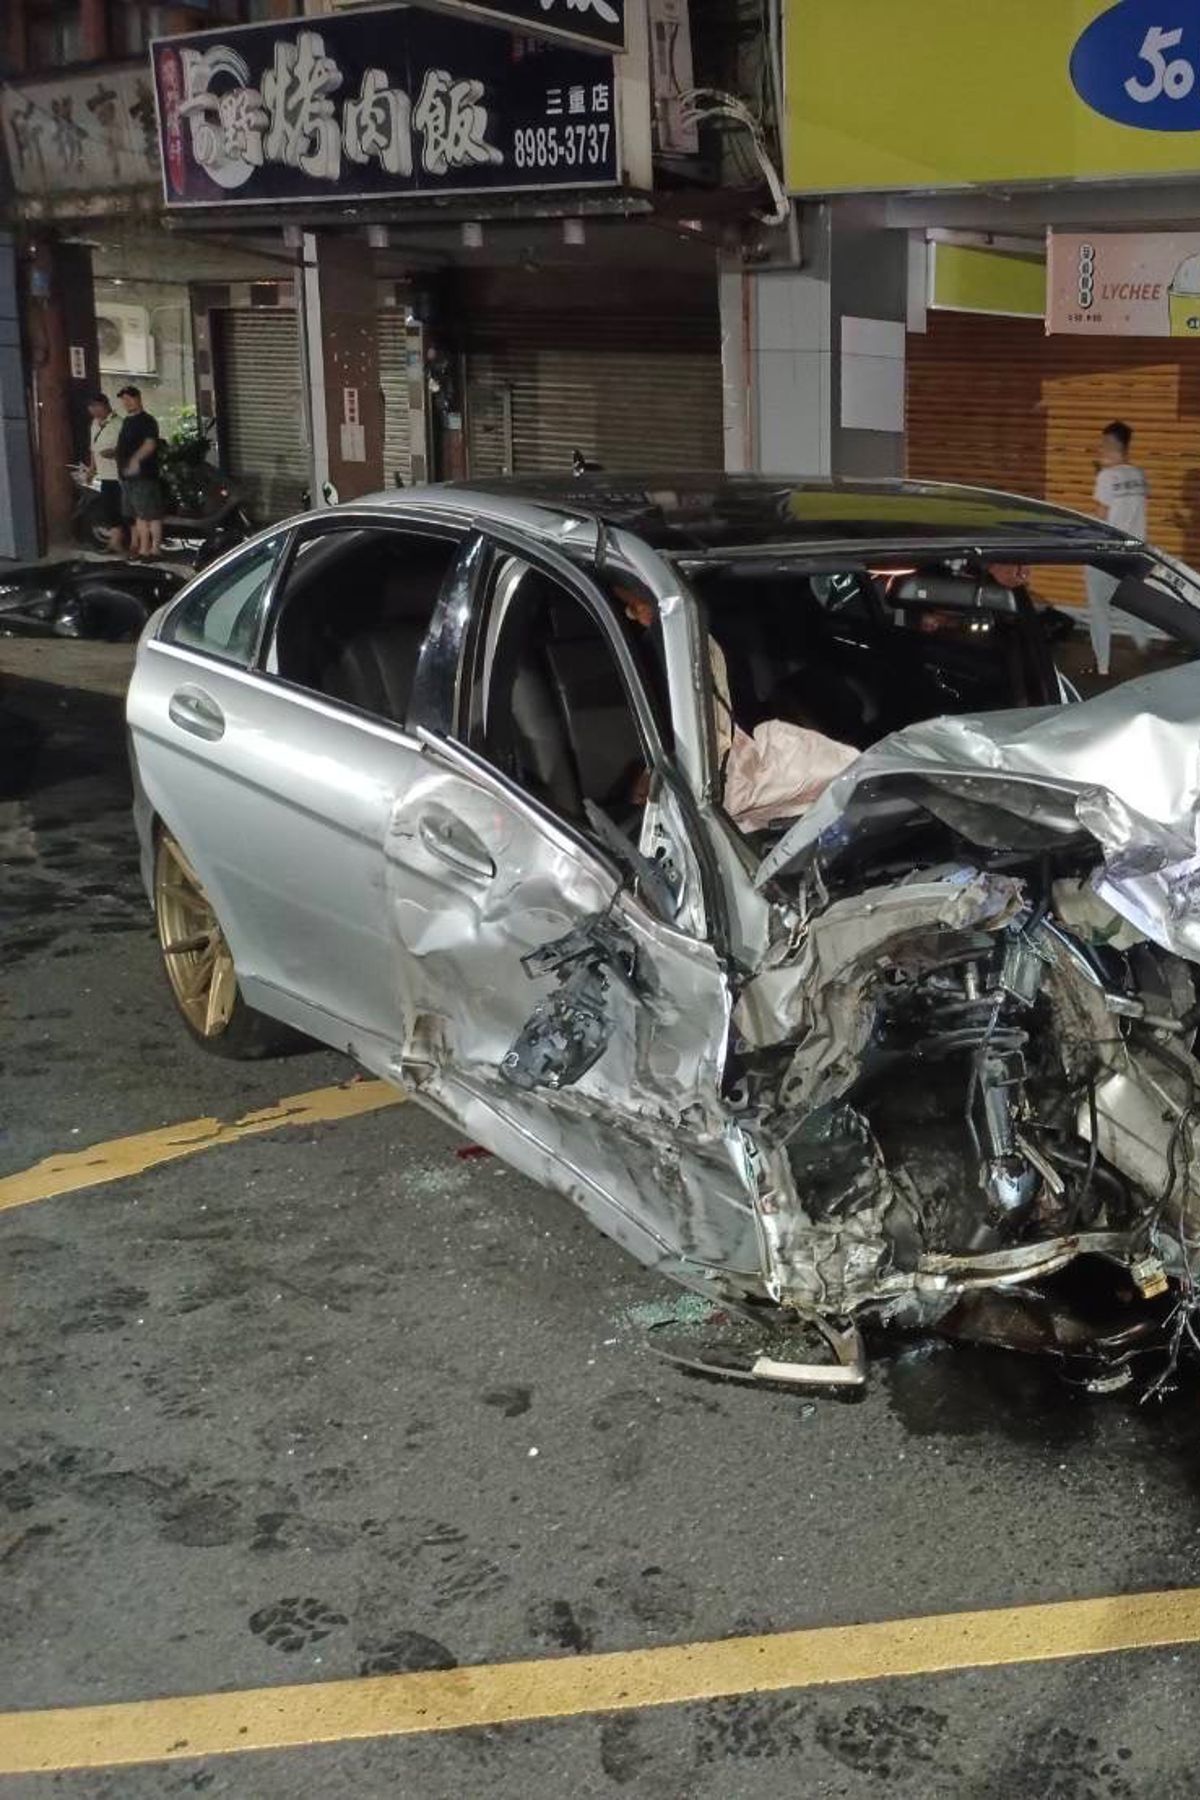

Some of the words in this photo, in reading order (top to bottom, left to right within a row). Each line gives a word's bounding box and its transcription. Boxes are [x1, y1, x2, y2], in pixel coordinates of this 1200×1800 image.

[546, 84, 609, 115] 三重店
[514, 124, 610, 168] 8985-3737
[1101, 283, 1161, 300] LYCHEE
